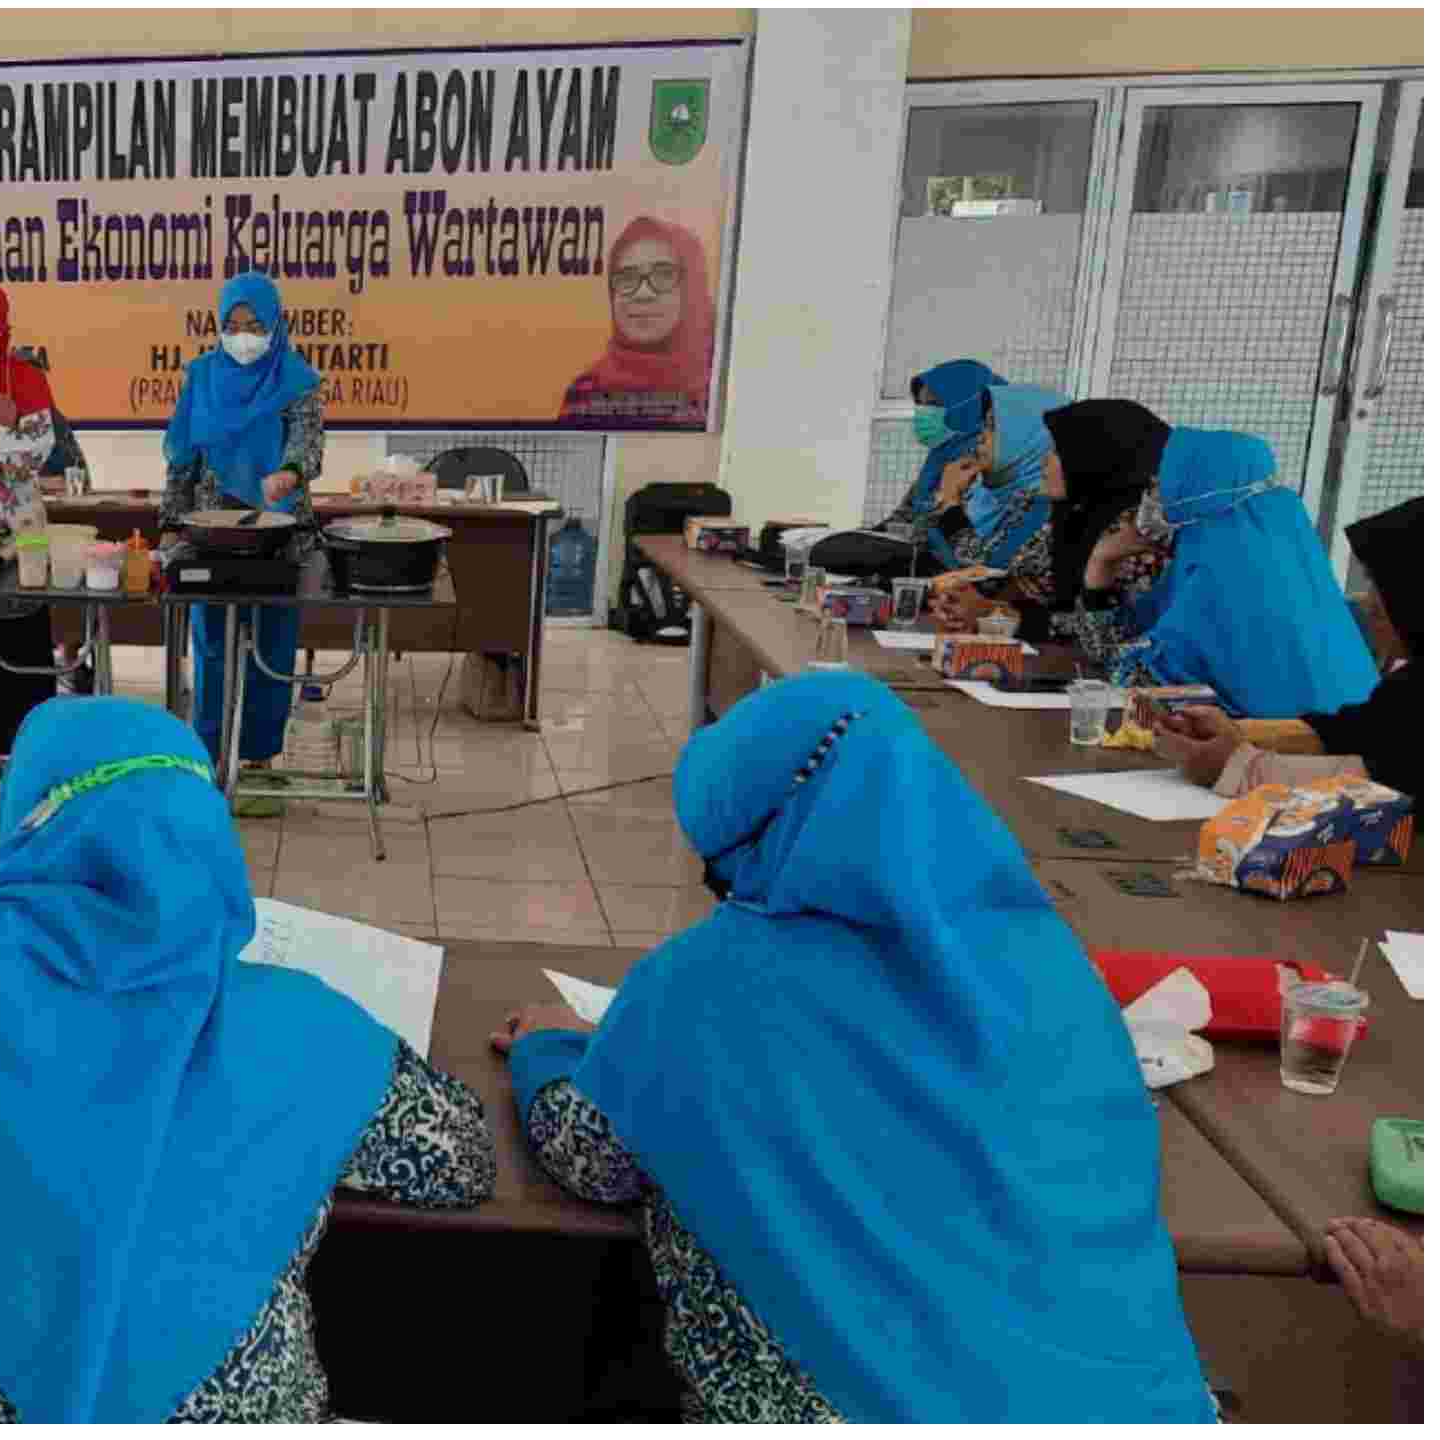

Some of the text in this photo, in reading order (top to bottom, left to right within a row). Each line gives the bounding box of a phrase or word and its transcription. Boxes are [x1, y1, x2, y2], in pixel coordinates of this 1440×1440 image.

[190, 72, 377, 178] MEMBUAT
[385, 68, 496, 174] ABON
[505, 66, 621, 172] AYAM
[56, 196, 213, 282] Ekonomi
[224, 194, 391, 294] Keluarga
[403, 189, 606, 278] Wartawan
[351, 375, 409, 411] RIAU)
